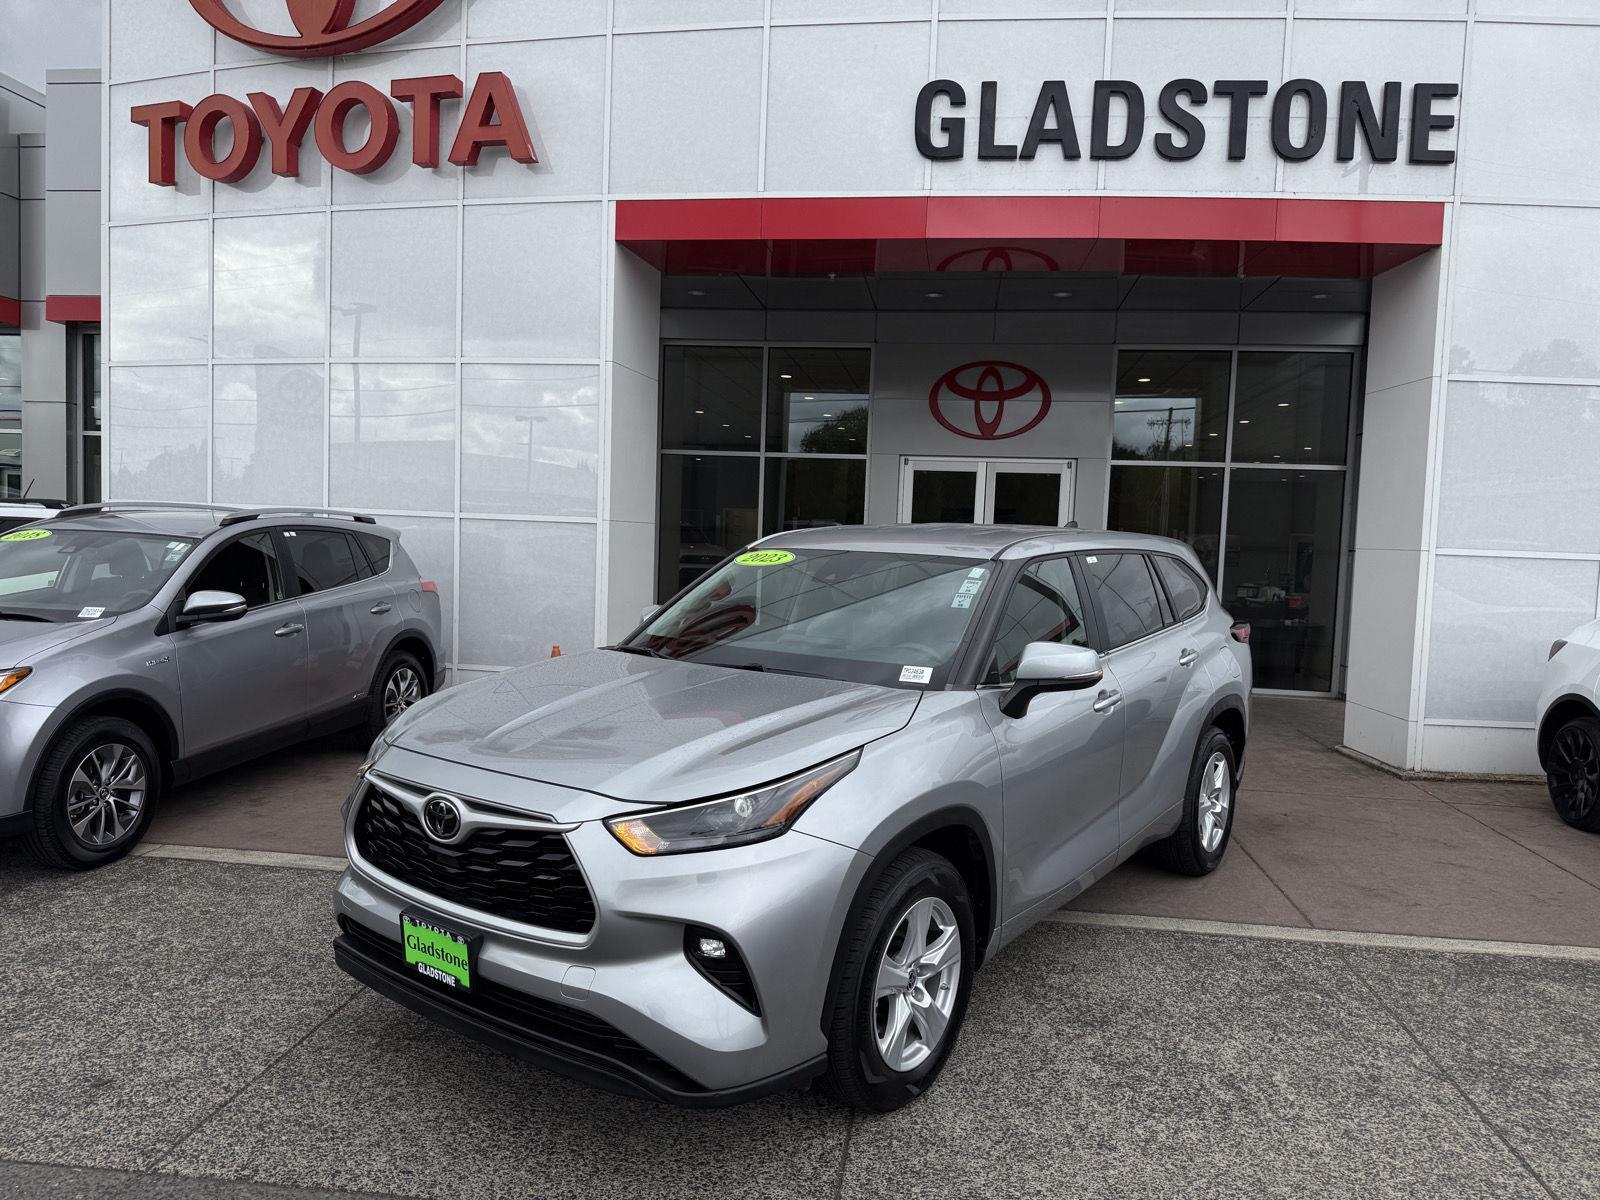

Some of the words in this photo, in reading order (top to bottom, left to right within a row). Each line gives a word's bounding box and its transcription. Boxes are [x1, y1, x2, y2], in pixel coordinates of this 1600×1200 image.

[131, 71, 539, 186] TOYOTA
[914, 78, 1459, 164] GLADSTONE
[741, 553, 788, 563] 2023
[415, 919, 452, 940] TOYOTA
[406, 934, 469, 972] Gladstone
[418, 962, 456, 988] GLADSTONE
